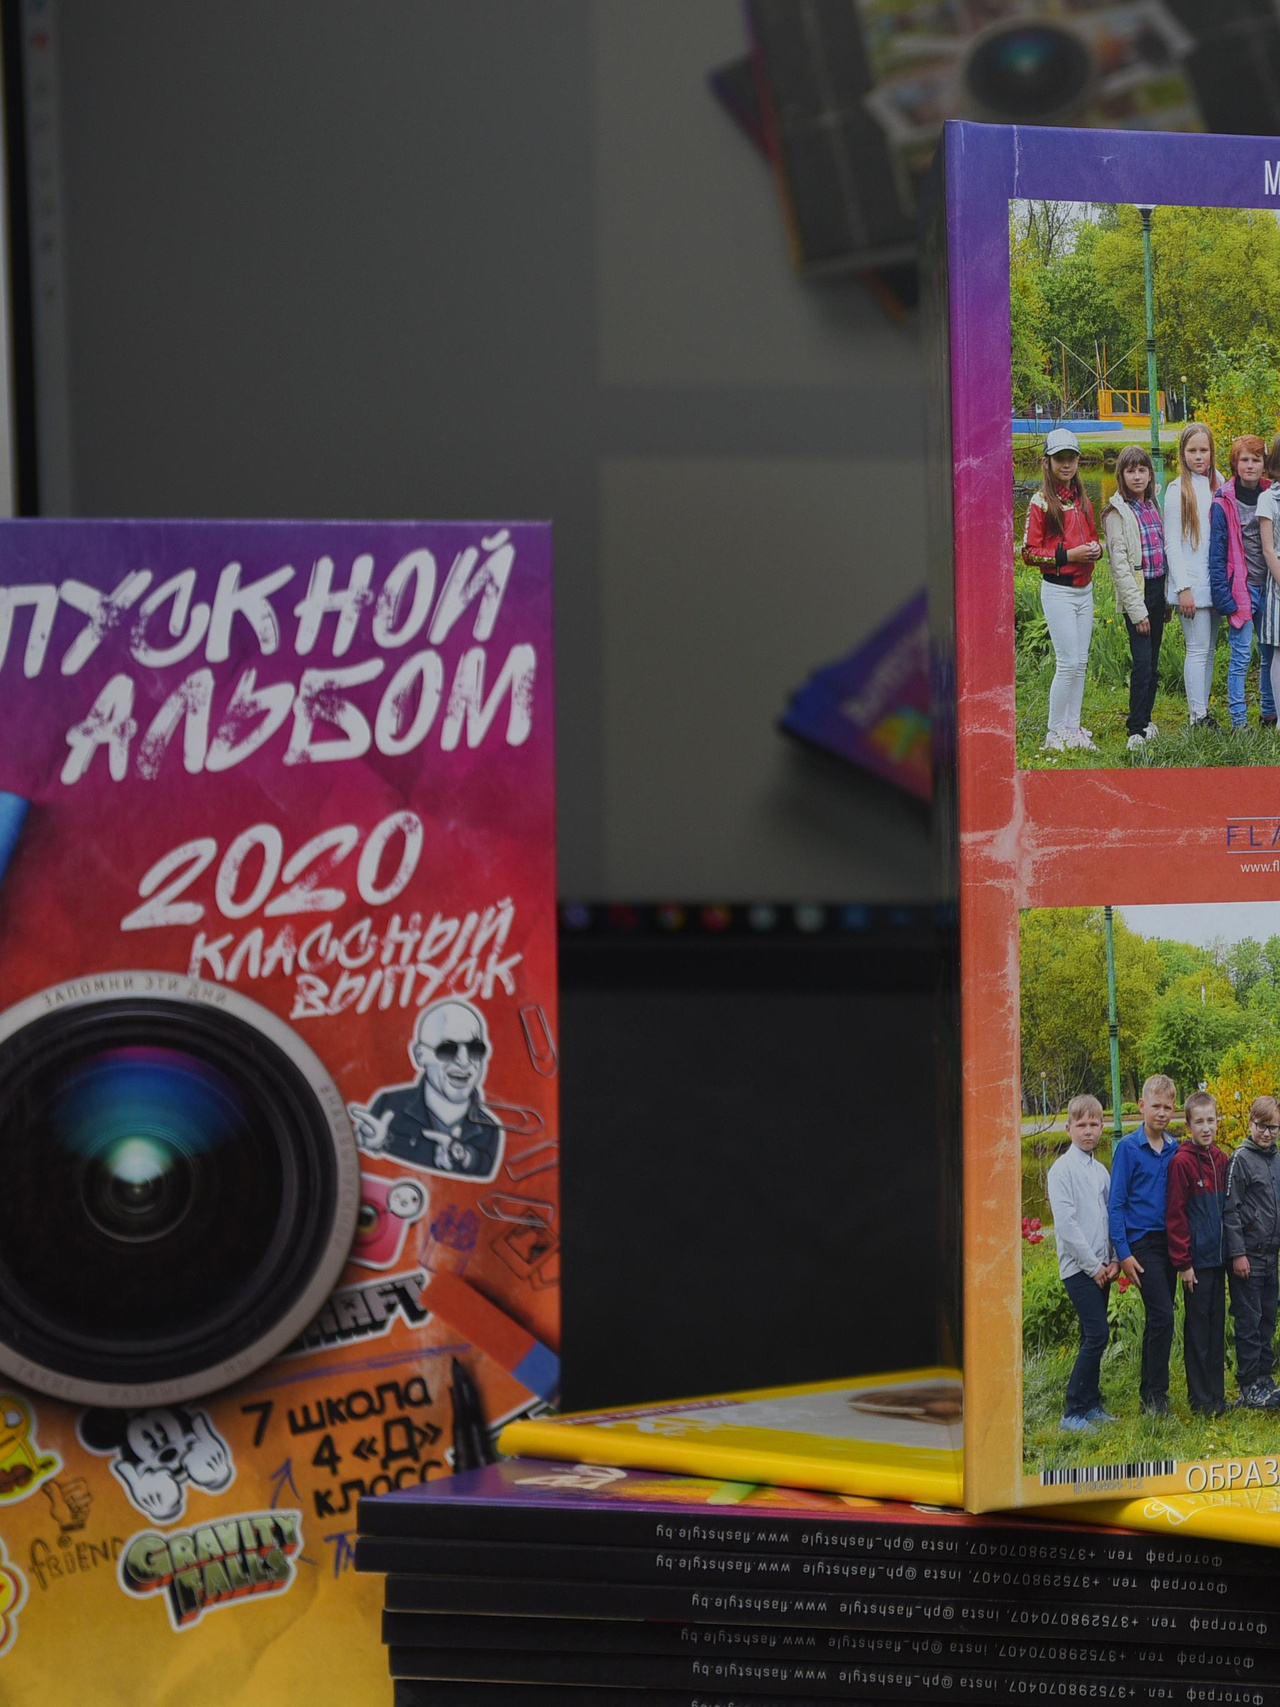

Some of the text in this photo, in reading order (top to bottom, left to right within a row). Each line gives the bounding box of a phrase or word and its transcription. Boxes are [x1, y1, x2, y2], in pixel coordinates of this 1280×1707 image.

[60, 643, 536, 784] АЛЬБОМ
[120, 810, 424, 932] 2020
[187, 895, 515, 981] КЛАССНЫЙ
[289, 951, 524, 1021] ВЫПУСК
[242, 1377, 432, 1446] 7 школа
[312, 1434, 342, 1475] 4
[125, 1516, 299, 1590] GRAVITY
[655, 1524, 1223, 1568] Фотограф тел. +375298070407, insta @ph_flashstyle www.flashstyle.by
[171, 1550, 291, 1623] FALLS
[655, 1555, 1228, 1595] Фотограф тел. +375298070407, insta @ph_flashstyle www.flashstyle.by
[691, 1594, 1268, 1635] Фотограф тел. +375298070407, insta @ph_flashstyle www.flashstyle.by
[681, 1628, 816, 1647] www.flashstyle.by
[828, 1636, 943, 1654] @ph_flashstyle
[949, 1642, 988, 1655] insta
[1134, 1651, 1164, 1662] тел.
[1176, 1650, 1255, 1669] Фотограф
[692, 1661, 1265, 1707] Фотограф тел. +375298070407, insta @ph_flashstyle www.flashstyle.by
